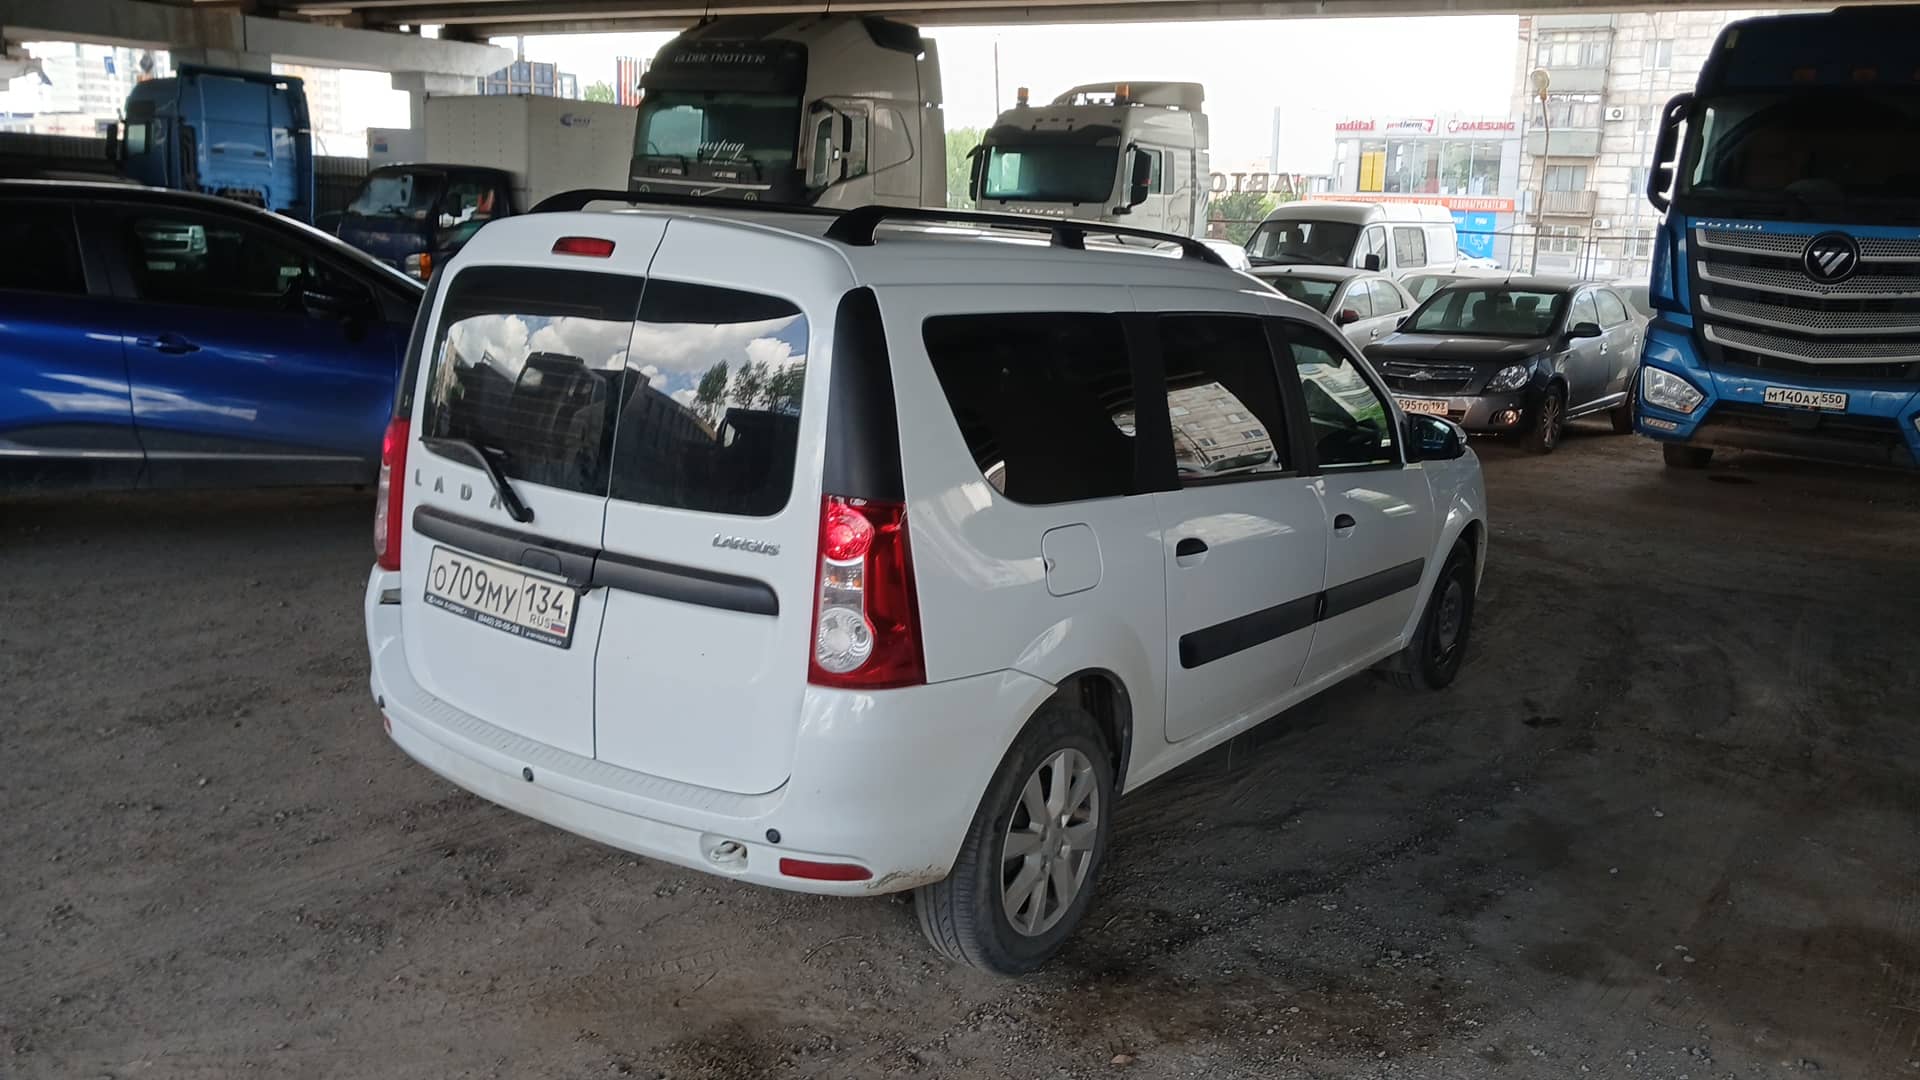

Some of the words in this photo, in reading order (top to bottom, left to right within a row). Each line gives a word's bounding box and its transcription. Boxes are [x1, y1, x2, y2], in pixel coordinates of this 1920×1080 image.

[1460, 121, 1516, 131] DAESUNG
[1768, 390, 1819, 405] М140АХ
[1821, 393, 1843, 404] 550
[414, 467, 502, 511] LADA
[433, 559, 519, 615] О709МУ
[525, 582, 565, 620] 134
[528, 613, 551, 629] RUS
